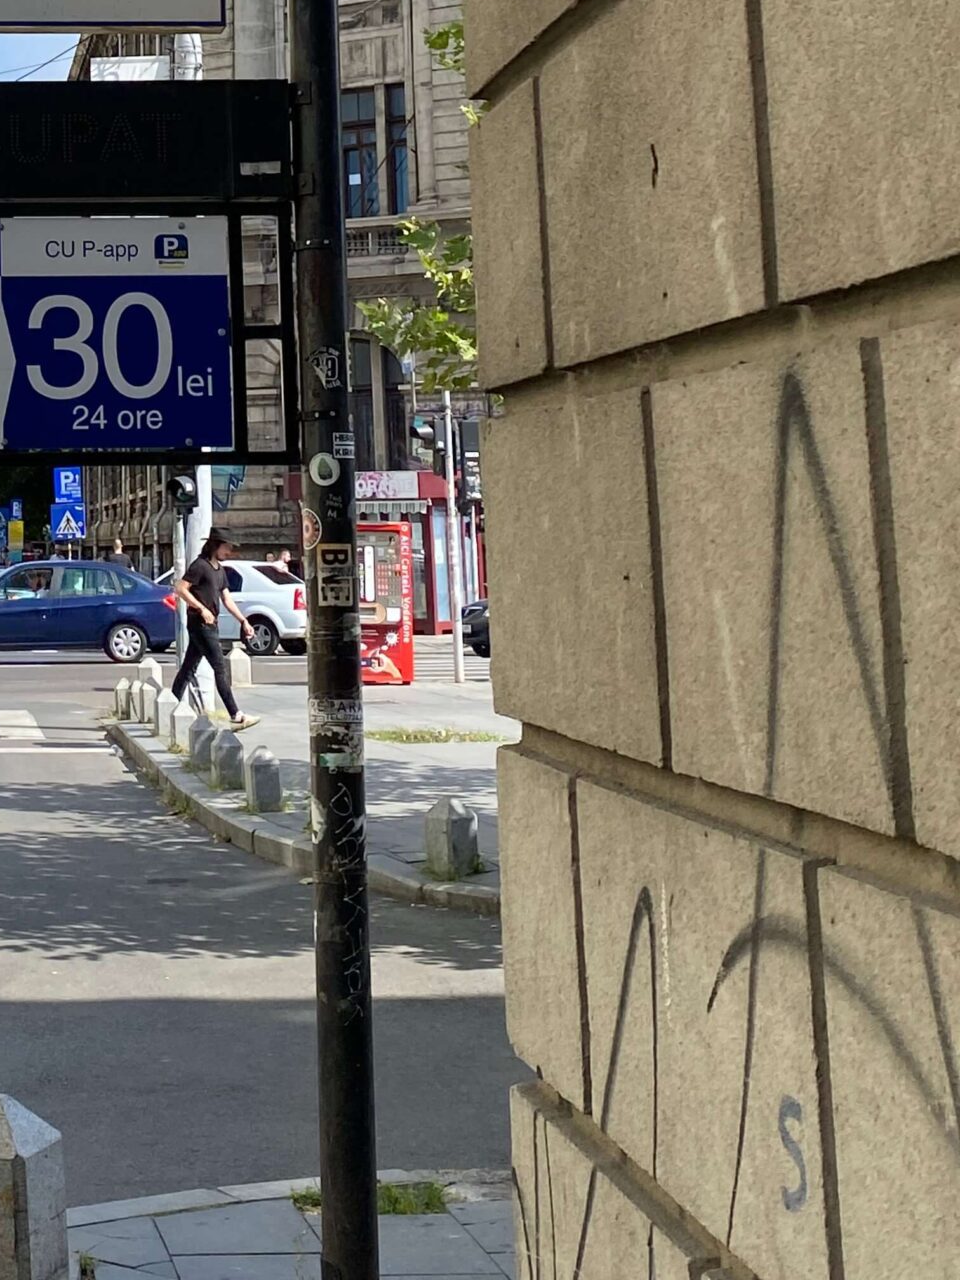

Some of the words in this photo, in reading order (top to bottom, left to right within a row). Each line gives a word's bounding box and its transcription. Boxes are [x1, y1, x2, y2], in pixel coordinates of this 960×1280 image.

[45, 240, 78, 259] CU
[82, 239, 139, 262] P-app
[26, 291, 173, 401] 30
[177, 367, 214, 397] lei
[72, 406, 113, 430] 24
[118, 410, 163, 431] ore
[401, 558, 411, 594] Cartela
[402, 596, 412, 644] Vodafone
